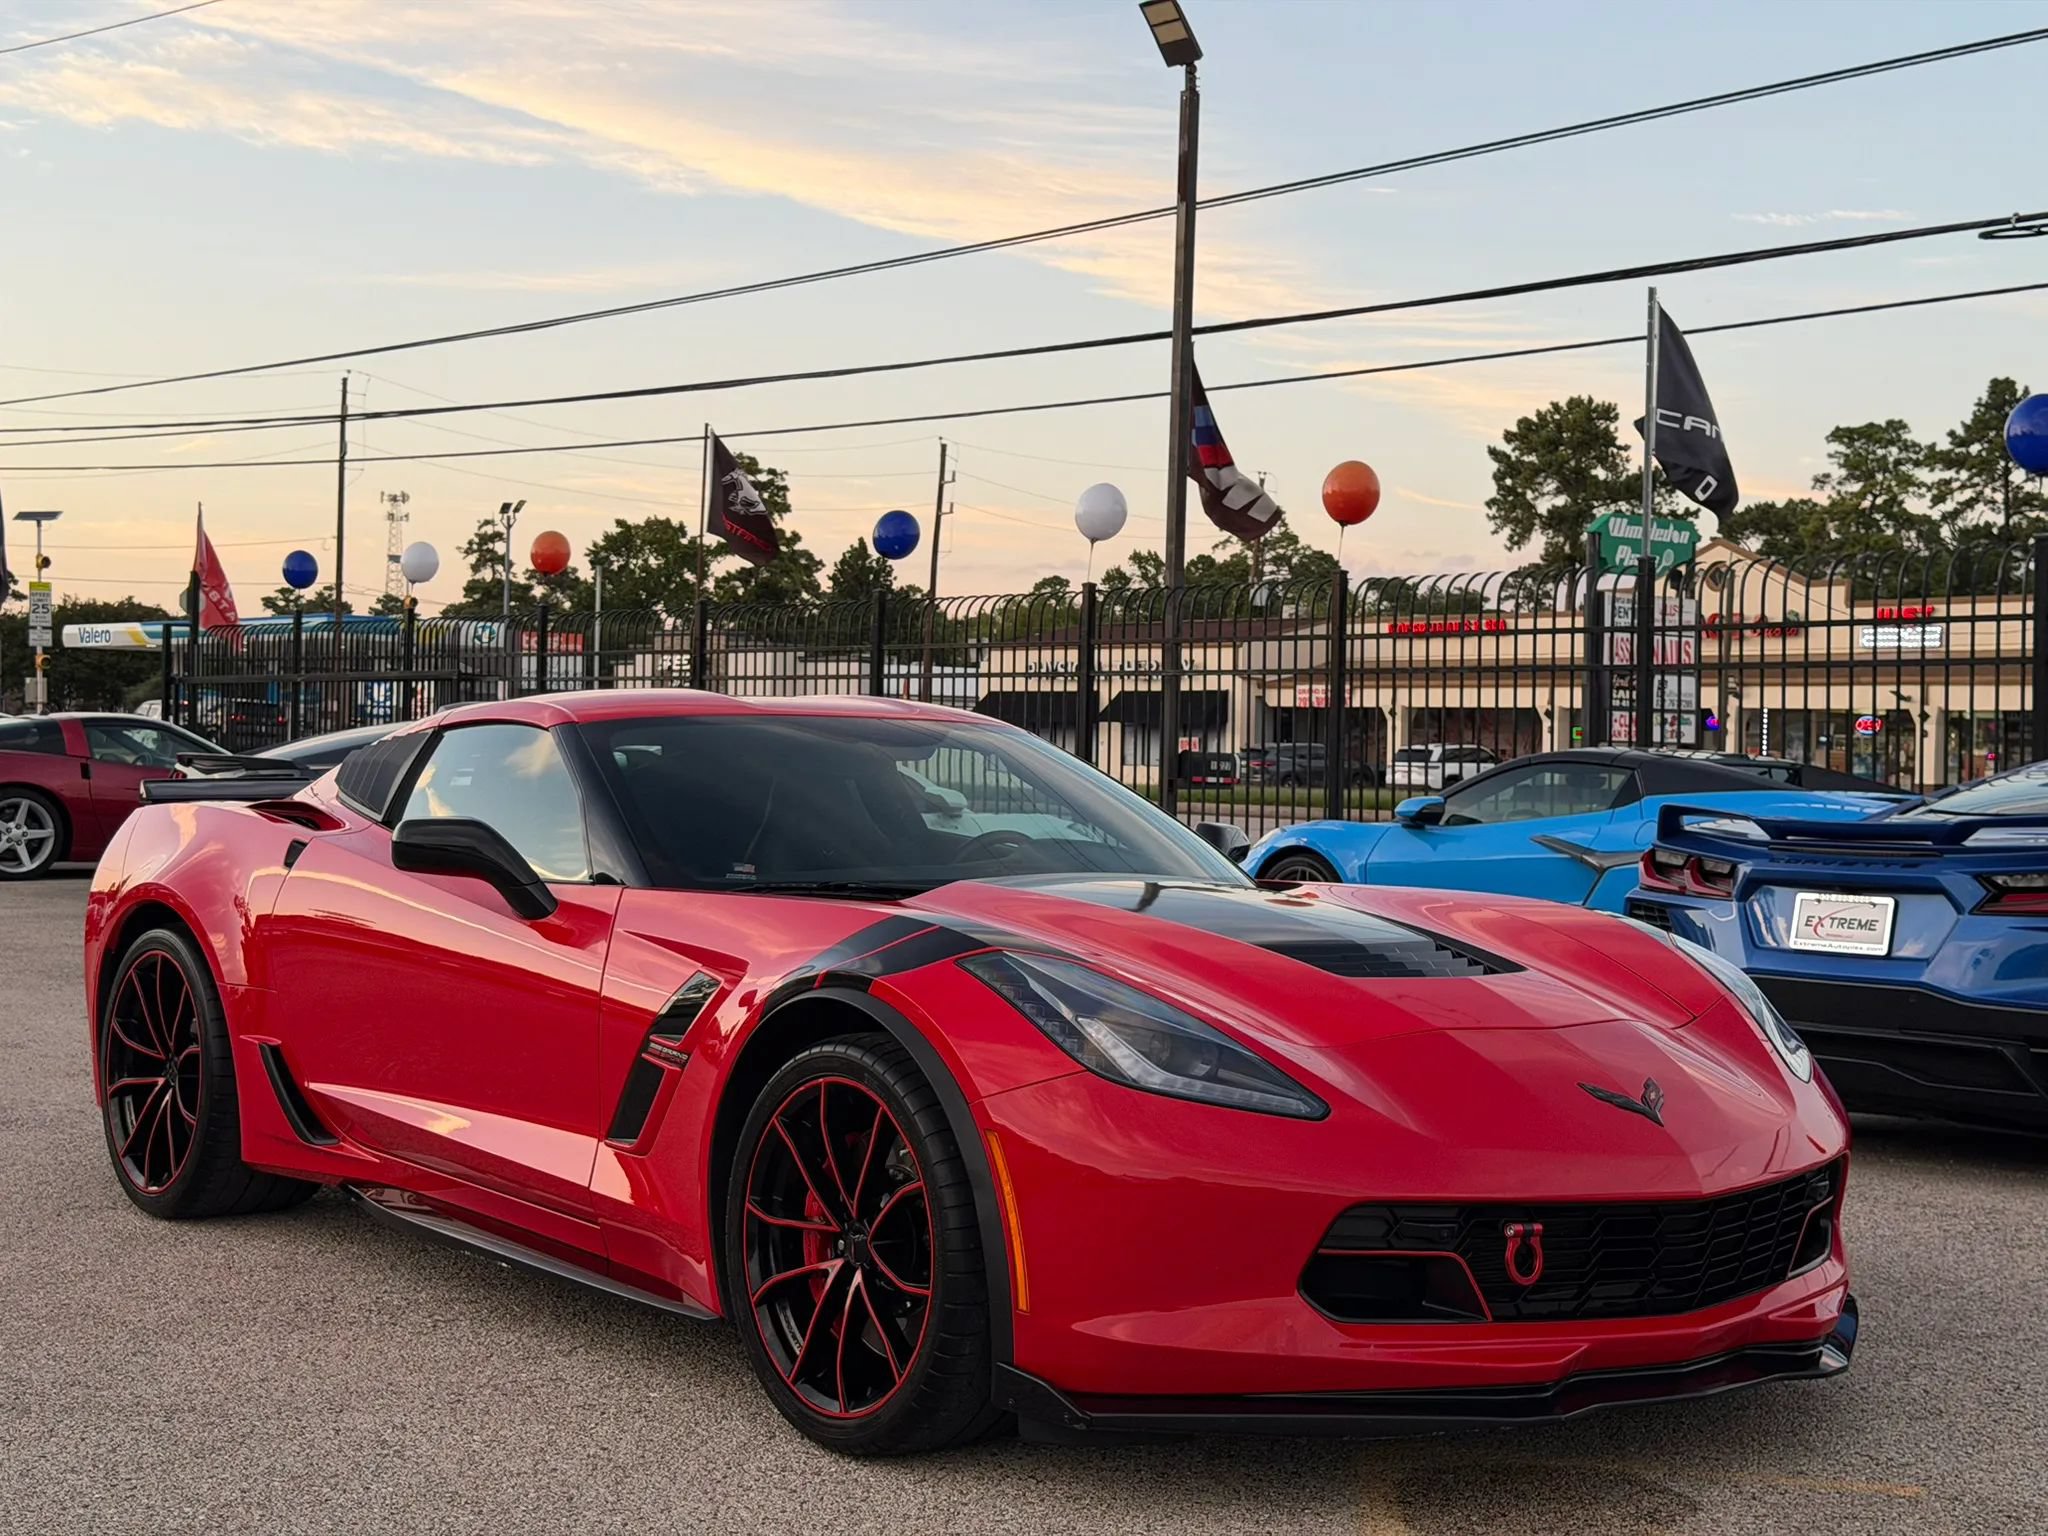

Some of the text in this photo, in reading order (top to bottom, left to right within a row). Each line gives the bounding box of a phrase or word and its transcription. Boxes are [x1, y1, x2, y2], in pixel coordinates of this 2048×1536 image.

[1608, 516, 1690, 544] Wimledon
[32, 604, 50, 614] 25
[78, 627, 111, 643] Valero
[1804, 915, 1880, 932] EXTREME
